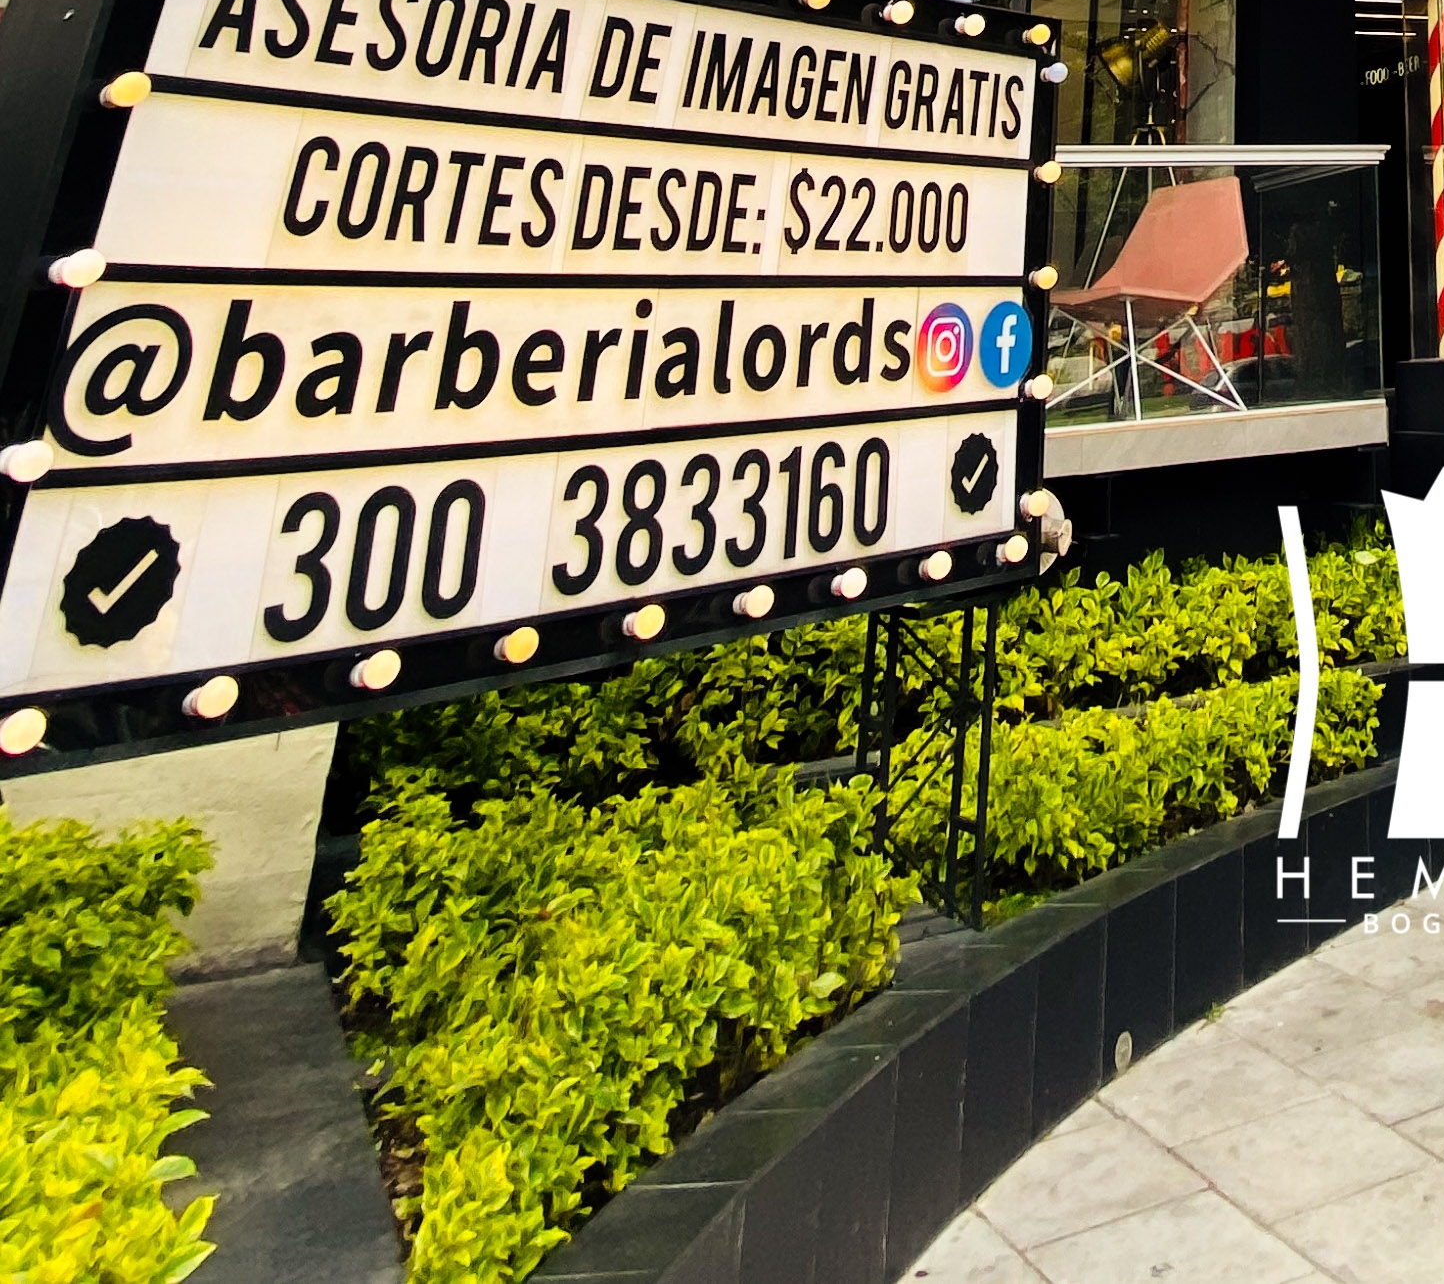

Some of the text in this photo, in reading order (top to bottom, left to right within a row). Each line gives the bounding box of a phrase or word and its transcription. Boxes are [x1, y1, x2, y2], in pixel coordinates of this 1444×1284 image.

[589, 16, 672, 104] DE
[682, 29, 877, 126] IMAGEN
[884, 59, 1025, 140] GRATIS
[283, 135, 969, 255] CORTES DESDE: $22.000
[47, 297, 912, 458] @barberialords
[263, 436, 891, 643] 300 3833160
